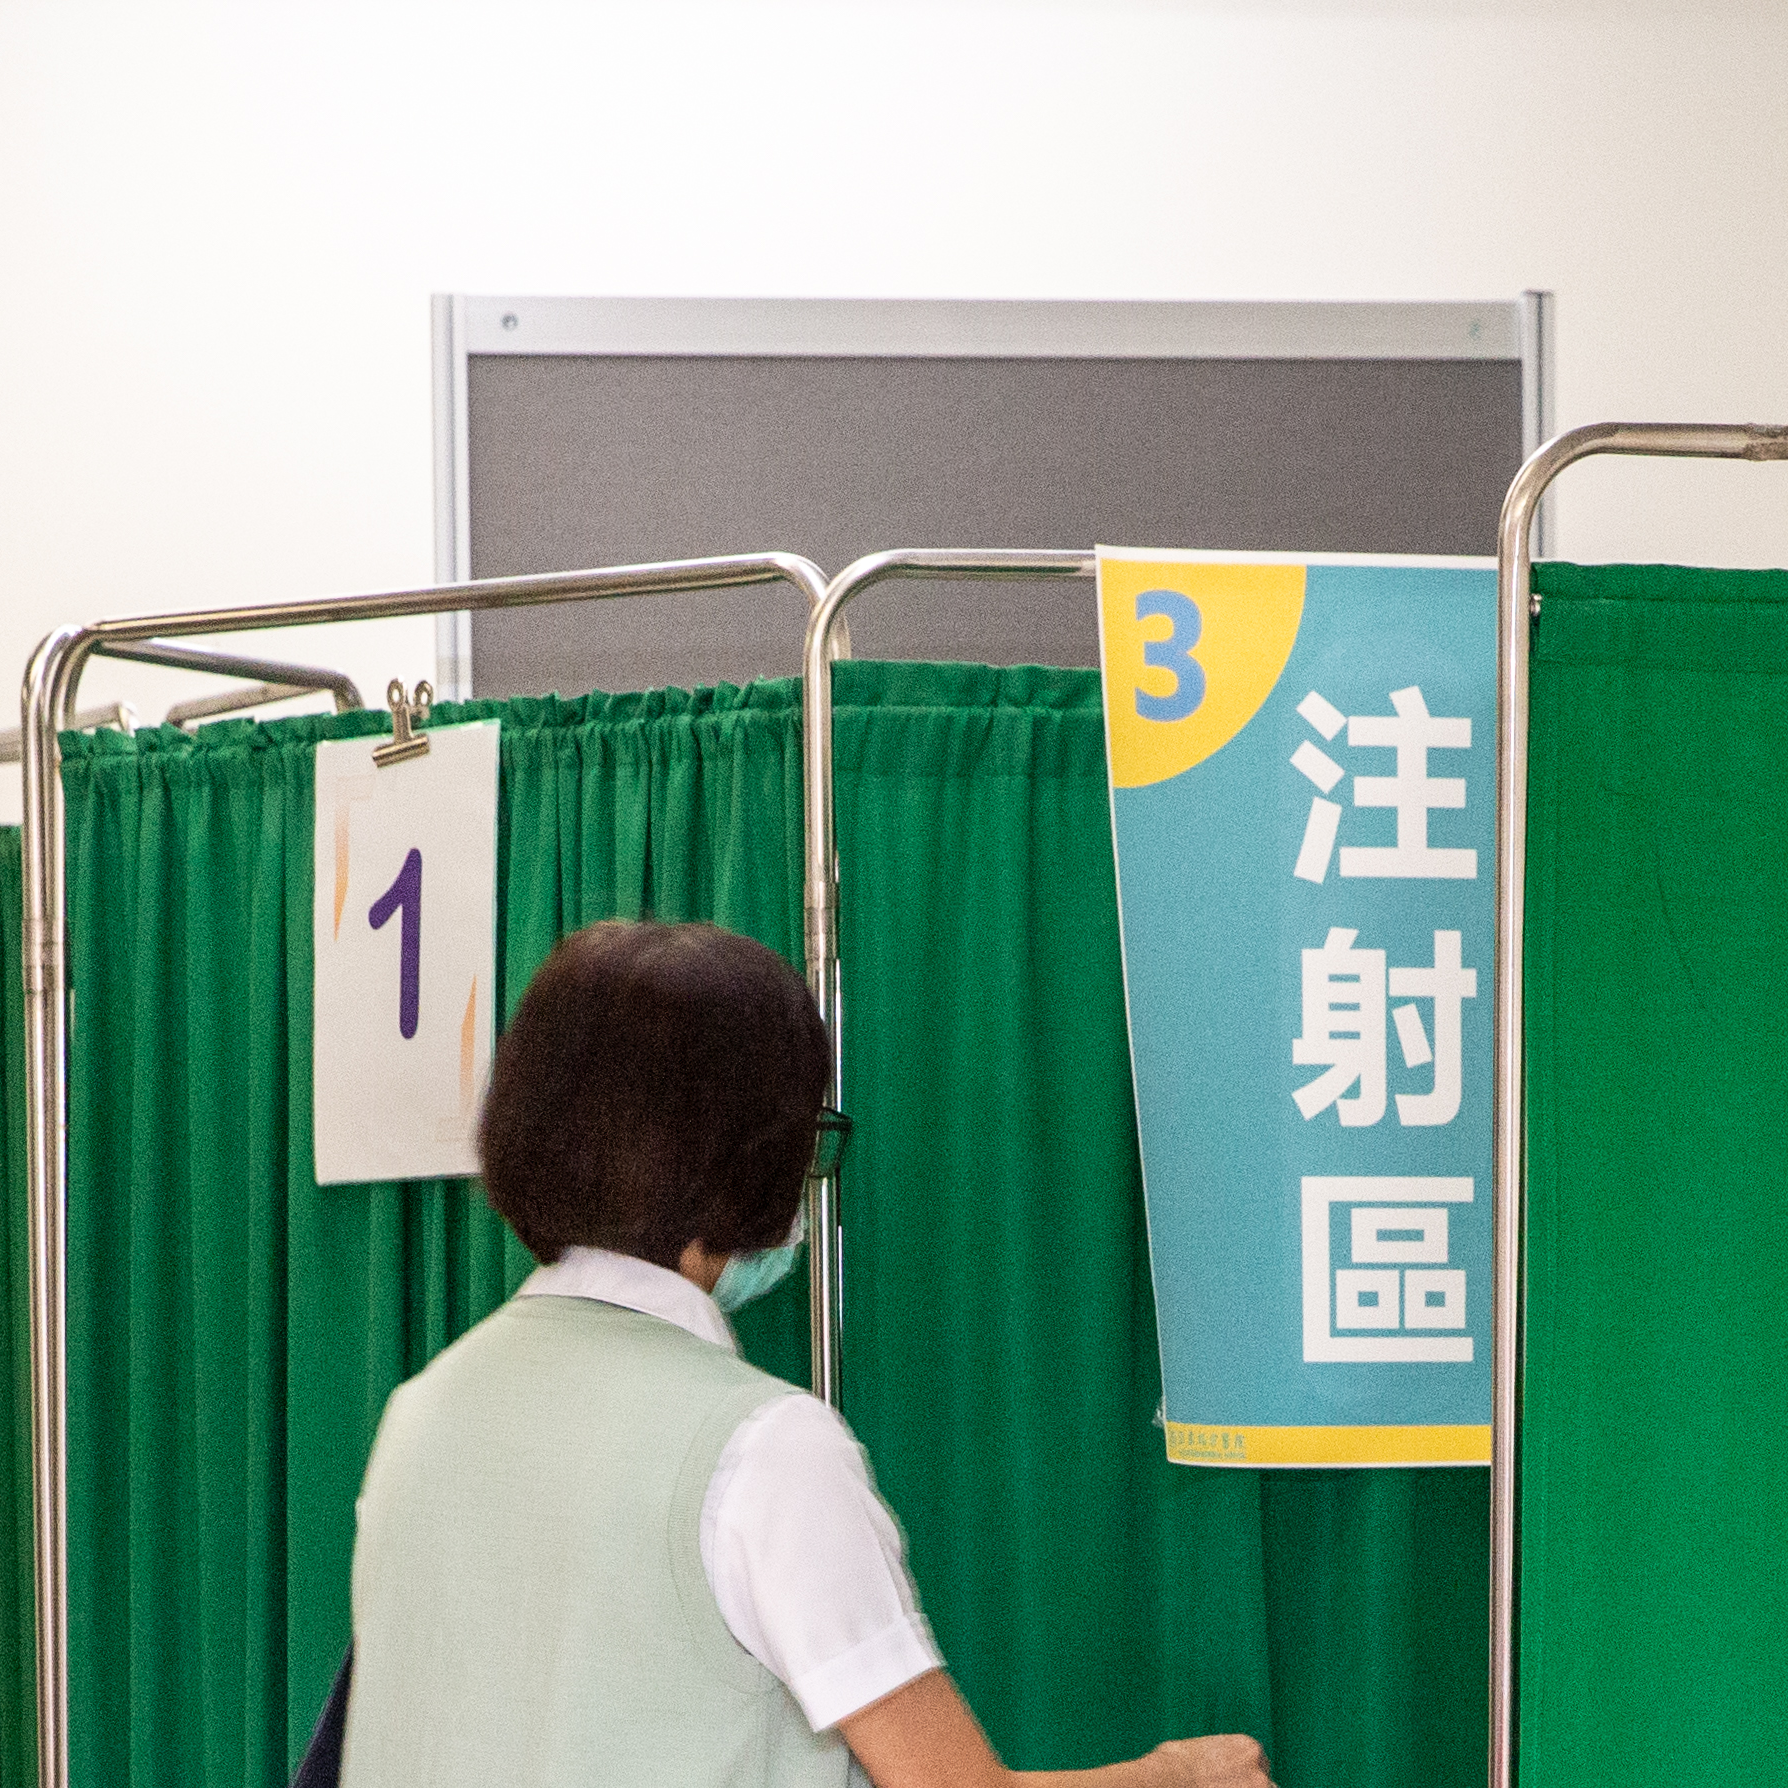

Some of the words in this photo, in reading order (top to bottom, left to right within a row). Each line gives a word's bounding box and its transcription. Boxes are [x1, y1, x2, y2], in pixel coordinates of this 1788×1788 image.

[1133, 589, 1206, 723] 3
[367, 847, 423, 1040] 1
[1289, 685, 1478, 1363] 注射區
